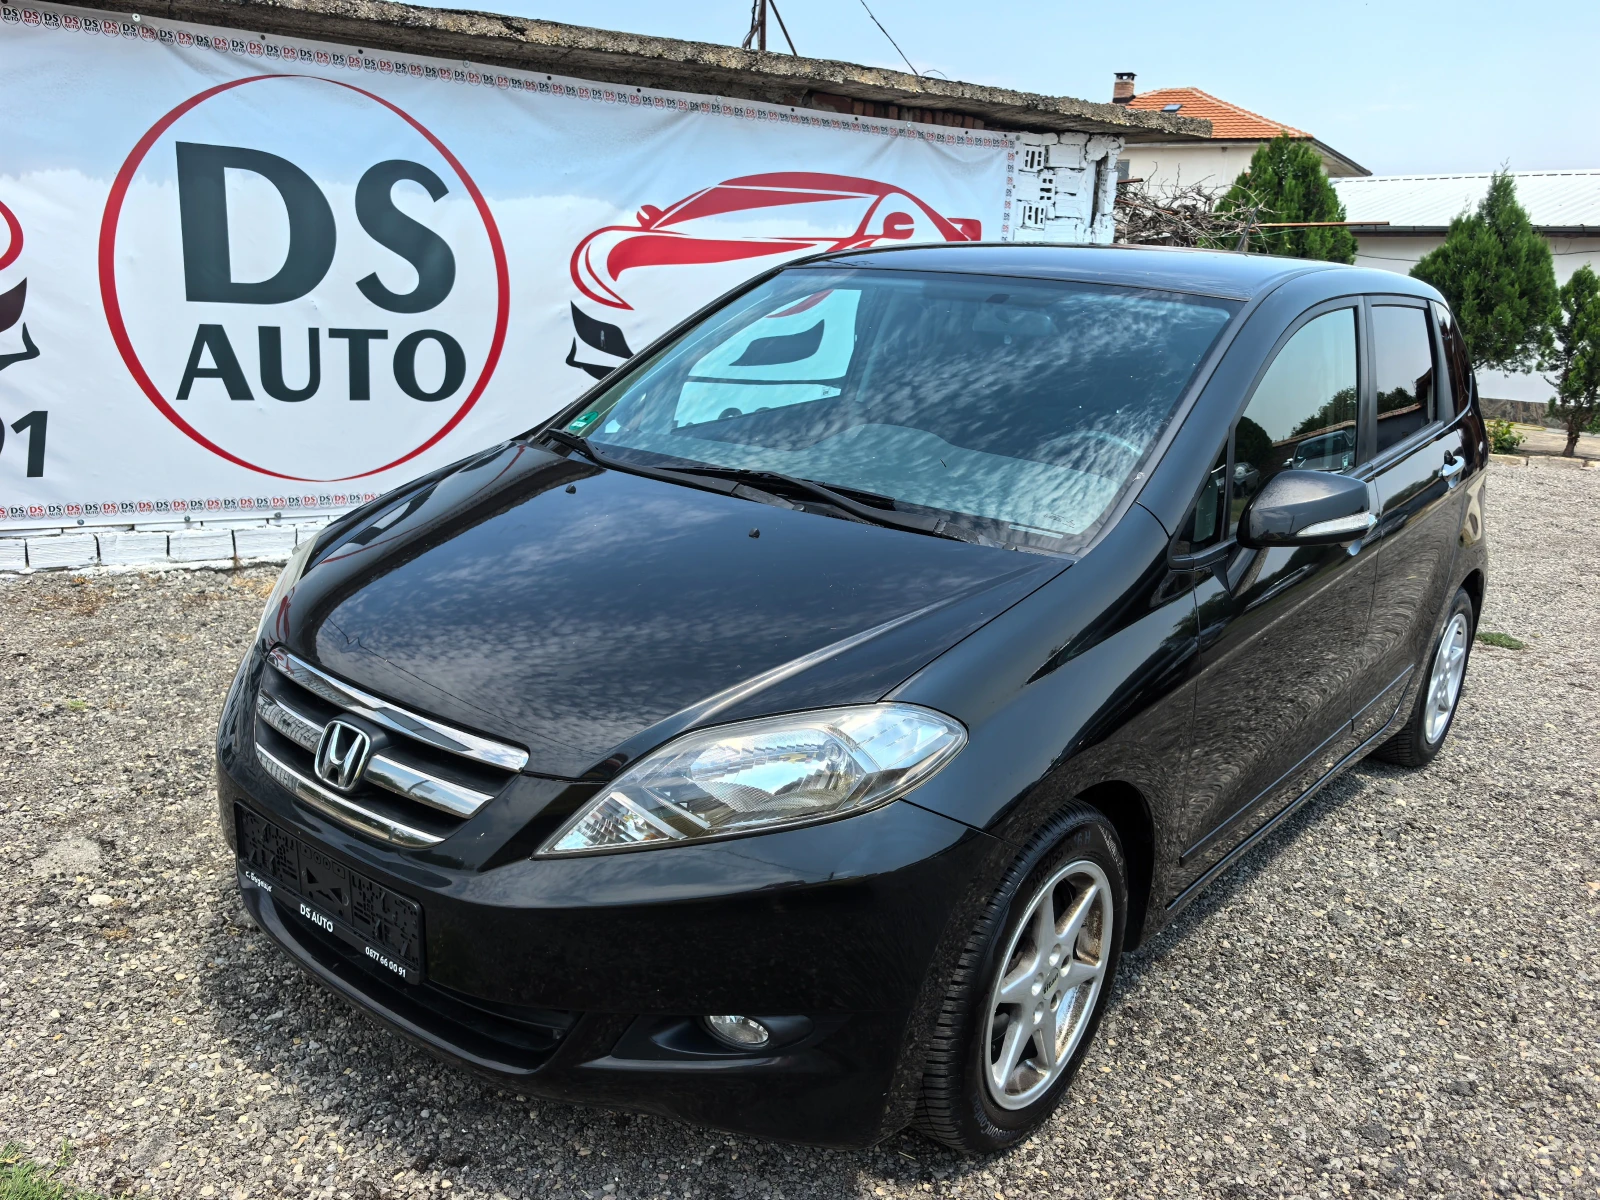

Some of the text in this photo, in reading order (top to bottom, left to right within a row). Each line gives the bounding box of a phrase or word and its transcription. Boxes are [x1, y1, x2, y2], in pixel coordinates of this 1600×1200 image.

[3, 8, 17, 16] DS
[24, 10, 38, 19] DS
[44, 13, 58, 22] DS
[64, 15, 78, 25] DS
[84, 18, 97, 28] DS
[104, 21, 117, 30] DS
[123, 24, 135, 33] DS
[141, 26, 154, 35] DS
[160, 30, 172, 39] DS
[178, 32, 190, 41] DS
[196, 35, 208, 44] DS
[214, 38, 226, 46] DS
[232, 40, 244, 48] DS
[250, 42, 261, 51] DS
[266, 45, 278, 53] DS
[283, 47, 295, 56] DS
[300, 49, 311, 58] DS
[316, 52, 328, 60] DS
[332, 54, 343, 62] DS
[348, 56, 359, 64] DS
[364, 58, 375, 66] DS
[176, 141, 456, 314] DS
[176, 324, 466, 402] AUTO
[0, 410, 48, 478] 1
[300, 903, 334, 932] DS AUTO
[380, 956, 388, 967] 66
[398, 967, 406, 978] 91
